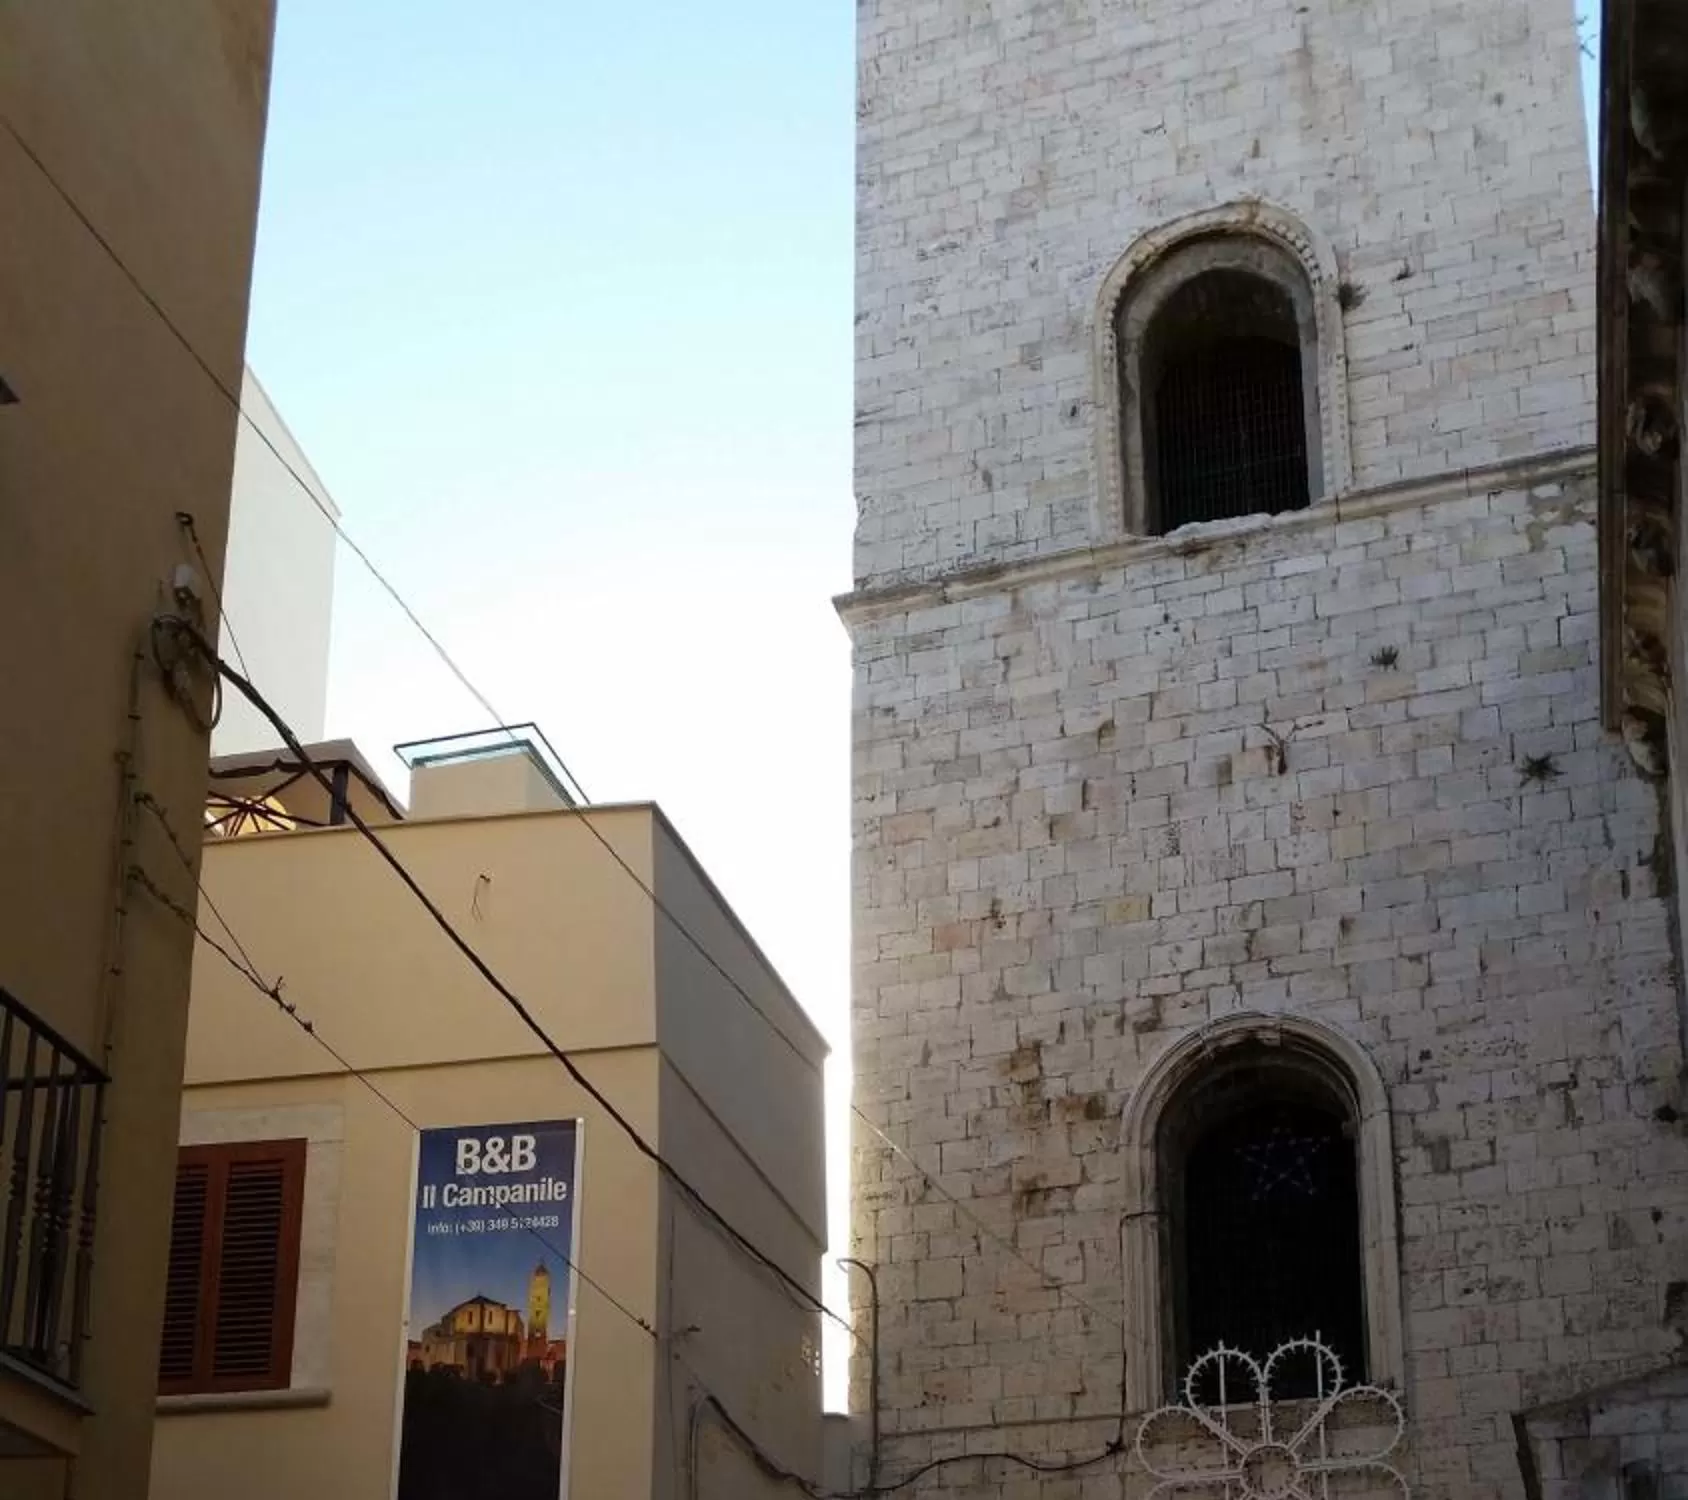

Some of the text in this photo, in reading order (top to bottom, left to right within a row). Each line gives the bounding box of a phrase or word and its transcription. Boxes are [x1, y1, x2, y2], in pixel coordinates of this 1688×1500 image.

[456, 1135, 536, 1175] B&B
[422, 1177, 567, 1209] Il Campanile
